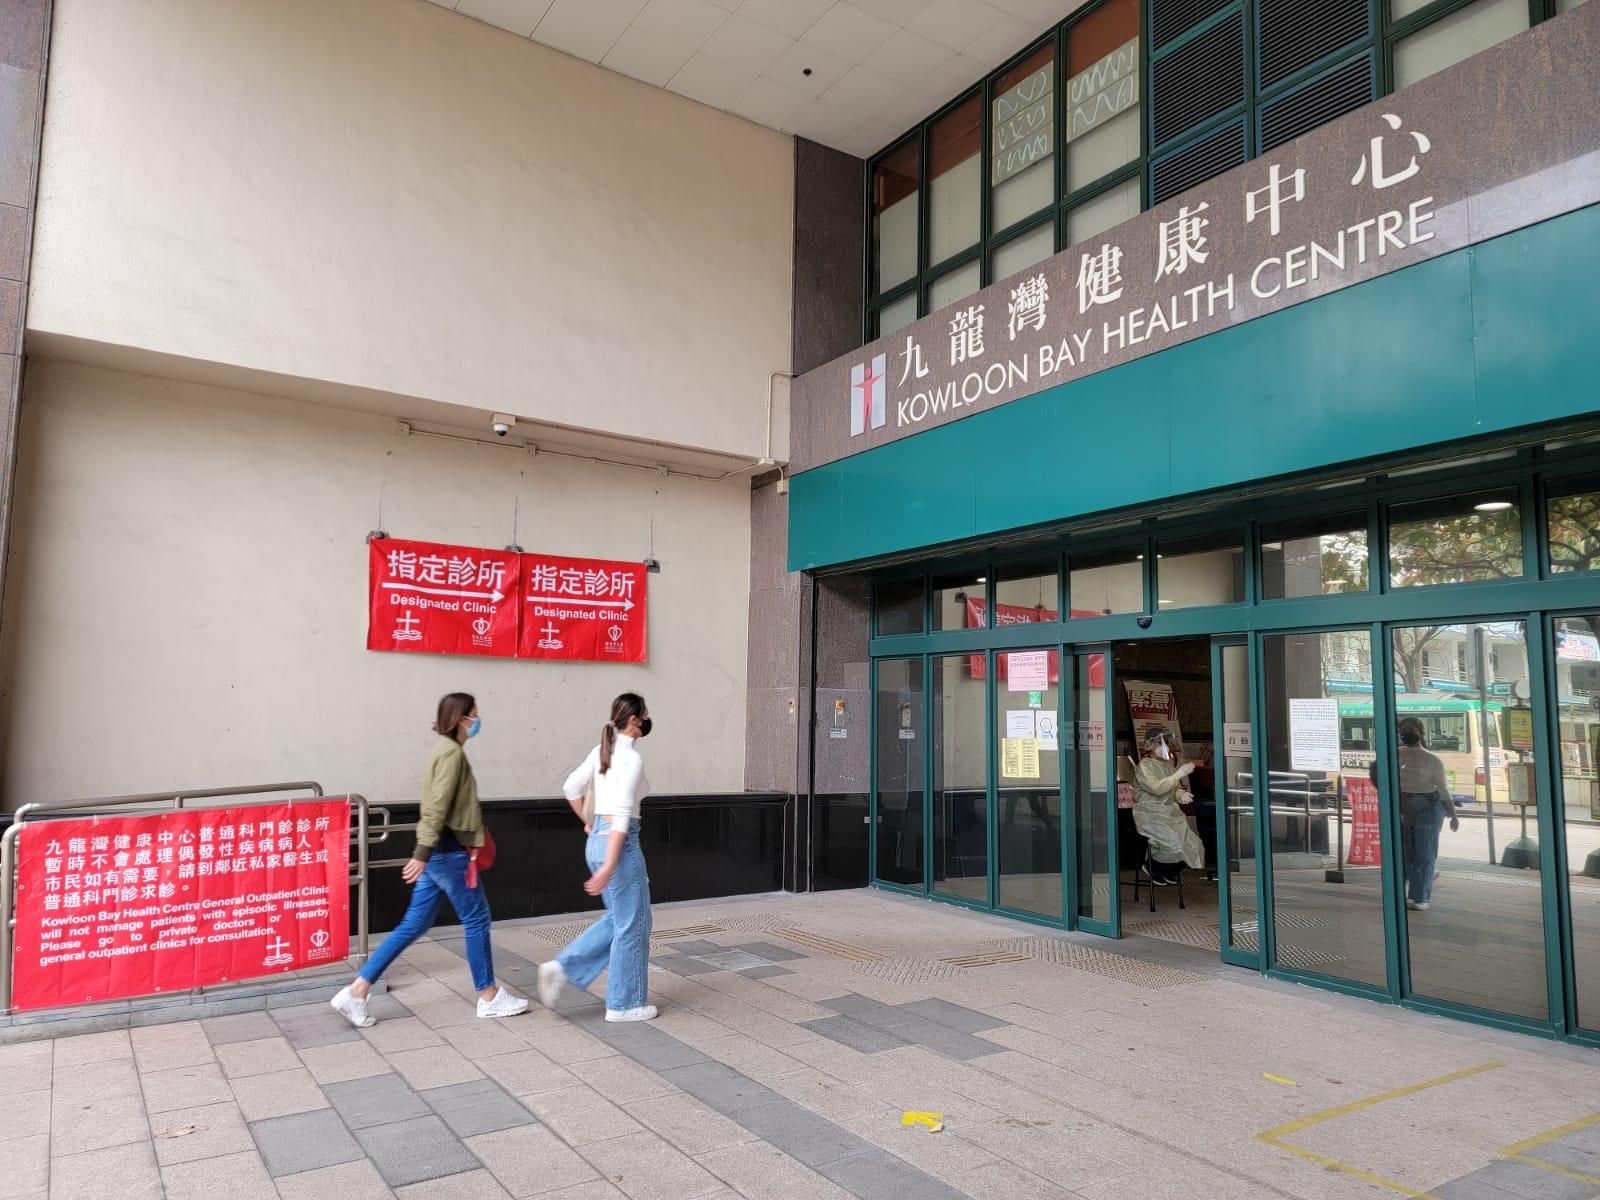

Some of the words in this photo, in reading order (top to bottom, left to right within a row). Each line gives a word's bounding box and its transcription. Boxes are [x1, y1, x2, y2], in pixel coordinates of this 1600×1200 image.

[898, 113, 1431, 388] 九龍灣健康中心
[897, 353, 1028, 427] KOWLOON
[1039, 328, 1092, 378] BAY
[1103, 273, 1234, 355] HEALTH
[1251, 196, 1434, 299] CENTRE
[387, 550, 506, 589] 指定診所
[531, 564, 635, 598] 指定診所
[390, 593, 459, 611] Designated
[463, 601, 497, 614] Clinic
[534, 606, 596, 620] Designated
[598, 609, 628, 621] Clinic
[45, 816, 330, 856] 九龍灣健康中心普通科門診診所
[41, 913, 96, 927] Kowloon
[98, 911, 121, 922] Bay
[123, 906, 160, 918] Health
[163, 902, 200, 914] Centre
[202, 895, 245, 909] General
[246, 888, 301, 903] Outpatient
[301, 885, 330, 896] Clinic
[41, 928, 62, 940] will
[69, 926, 90, 937] not
[96, 920, 144, 934] manage
[150, 913, 196, 929] patients
[202, 909, 226, 920] with
[232, 903, 277, 918] episodic
[283, 898, 330, 910] illnesses.
[39, 950, 85, 967] general
[88, 943, 147, 959] outpatient
[149, 937, 187, 951] clinics
[189, 934, 205, 945] for
[207, 926, 276, 944] consultation.
[40, 939, 81, 952] Please
[98, 937, 114, 947] go
[130, 932, 143, 942] to
[159, 925, 197, 939] private
[213, 918, 255, 931] doctors
[269, 914, 282, 923] or
[296, 908, 330, 920] nearby
